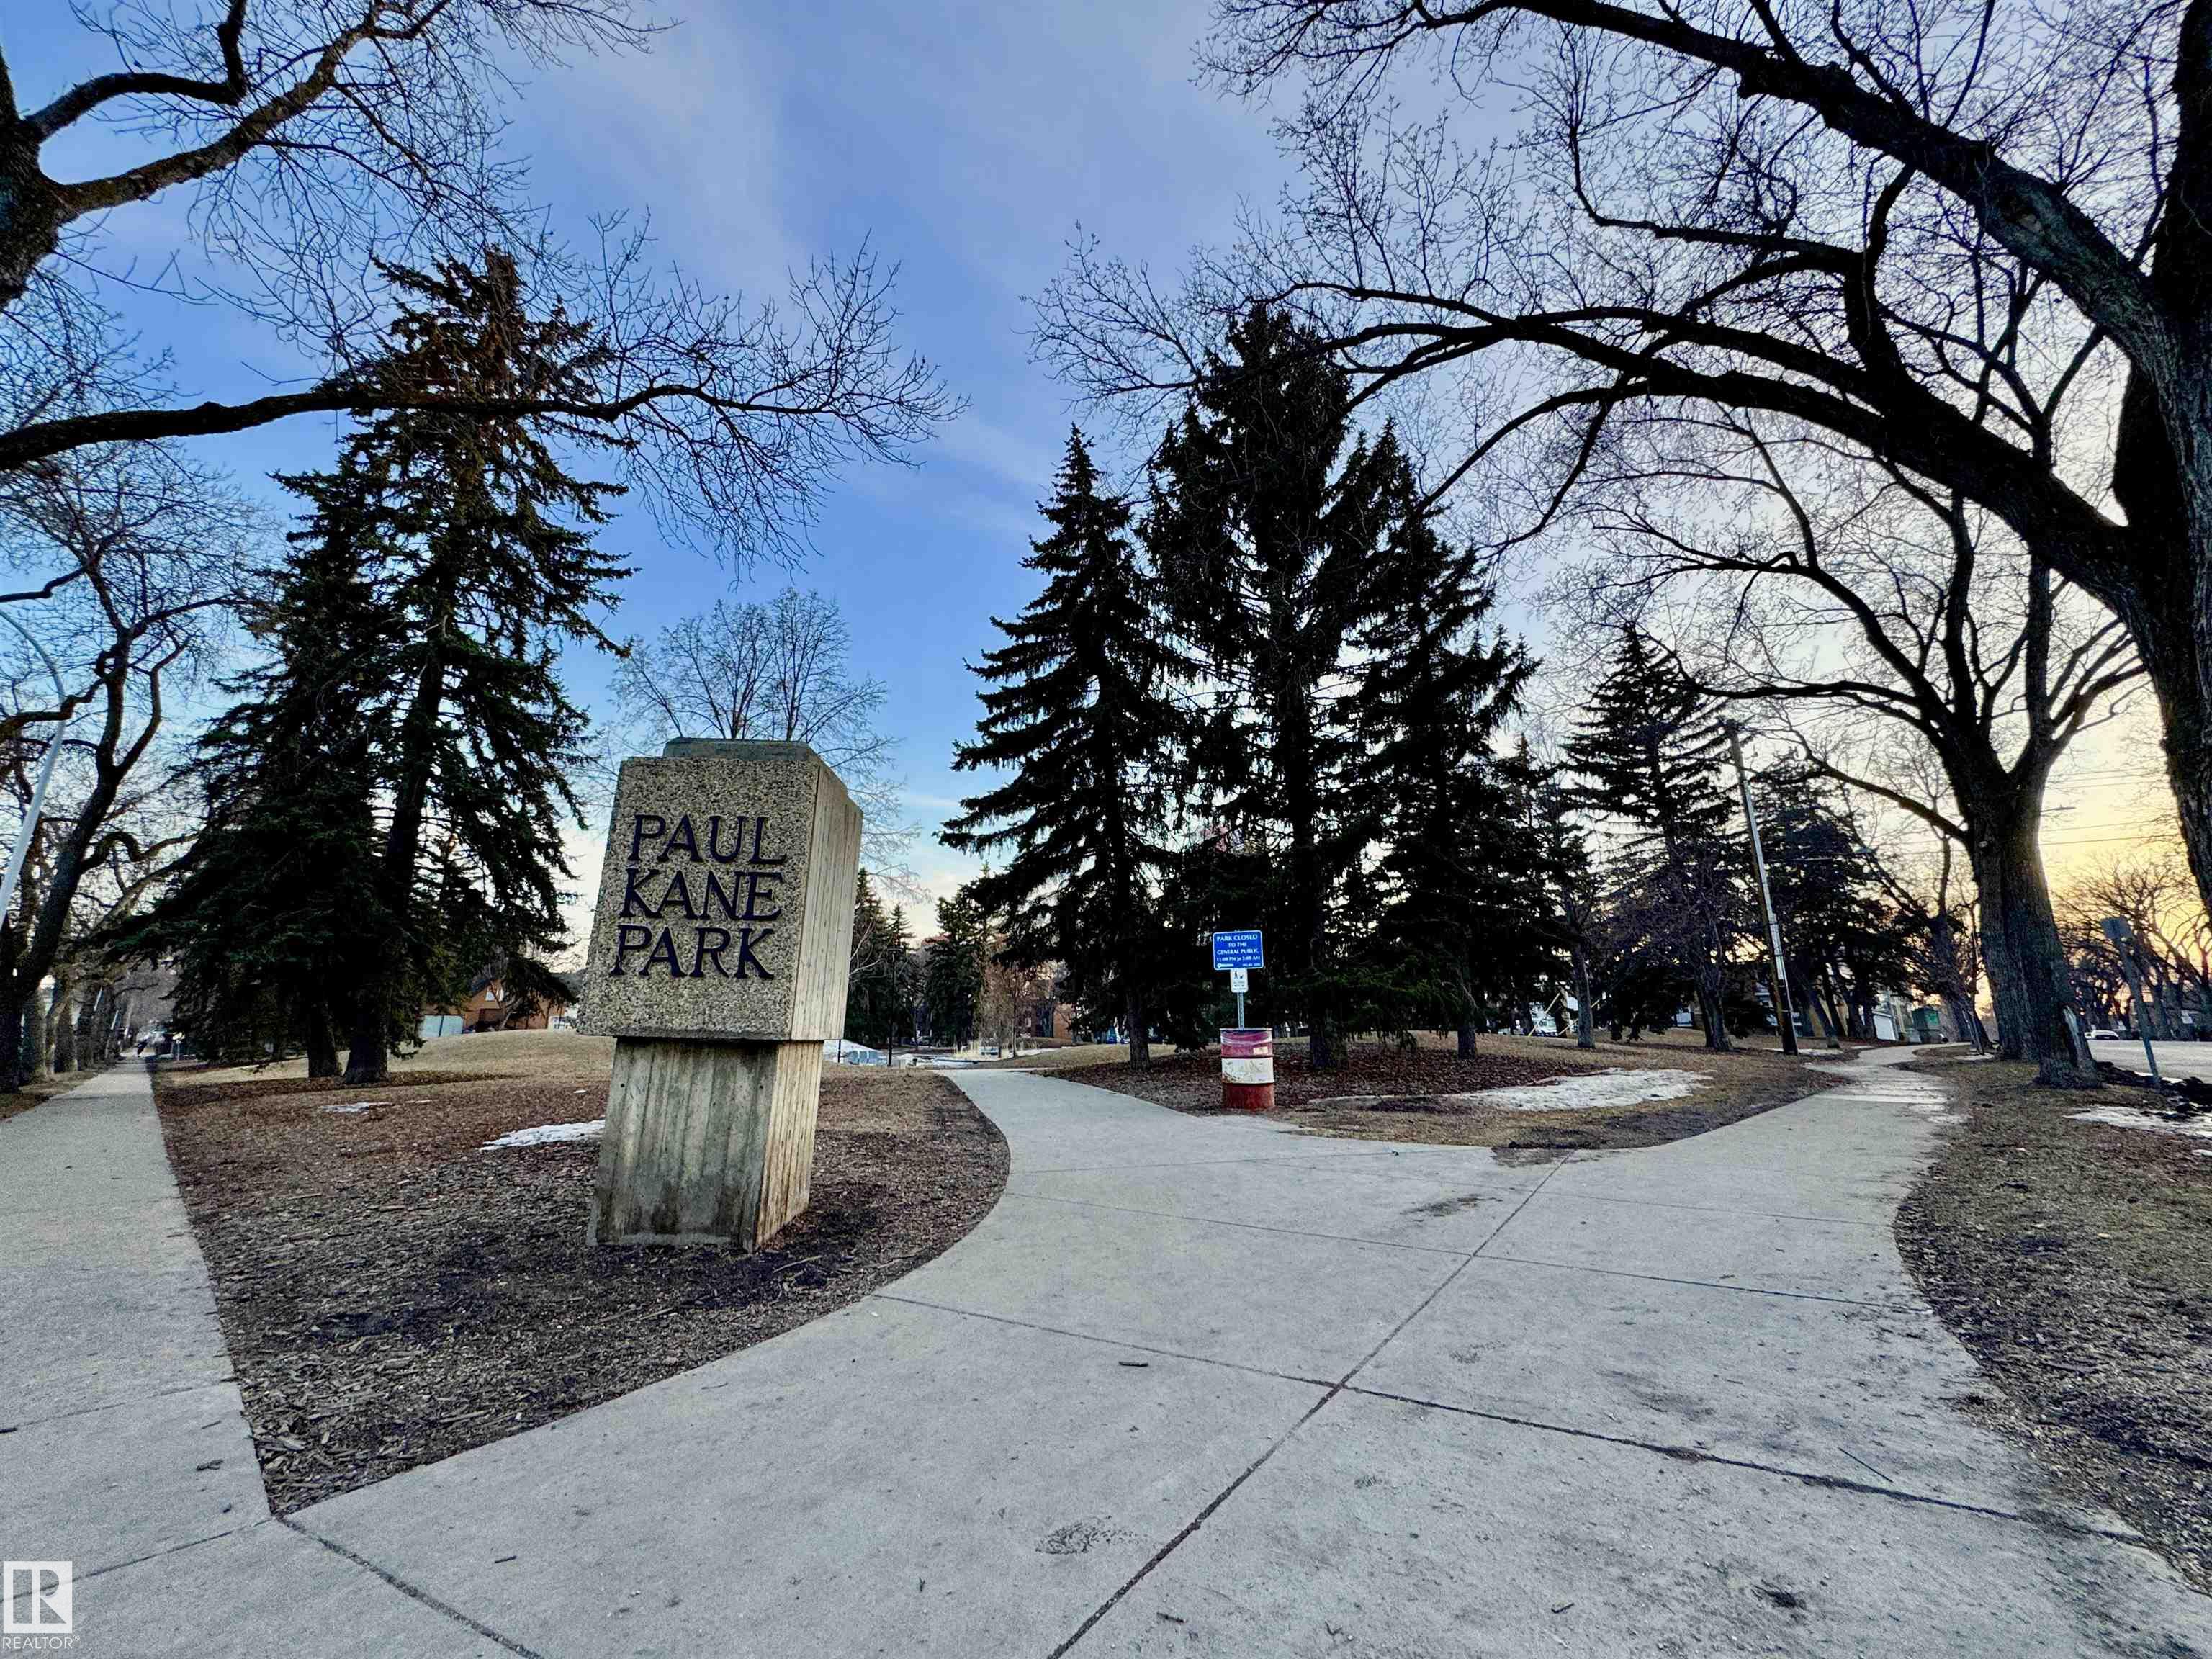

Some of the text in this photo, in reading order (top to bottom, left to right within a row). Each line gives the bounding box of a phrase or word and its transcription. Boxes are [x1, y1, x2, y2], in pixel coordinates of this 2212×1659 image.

[627, 814, 787, 864] PAUL
[618, 868, 783, 921] KANE
[610, 925, 775, 979] PARK
